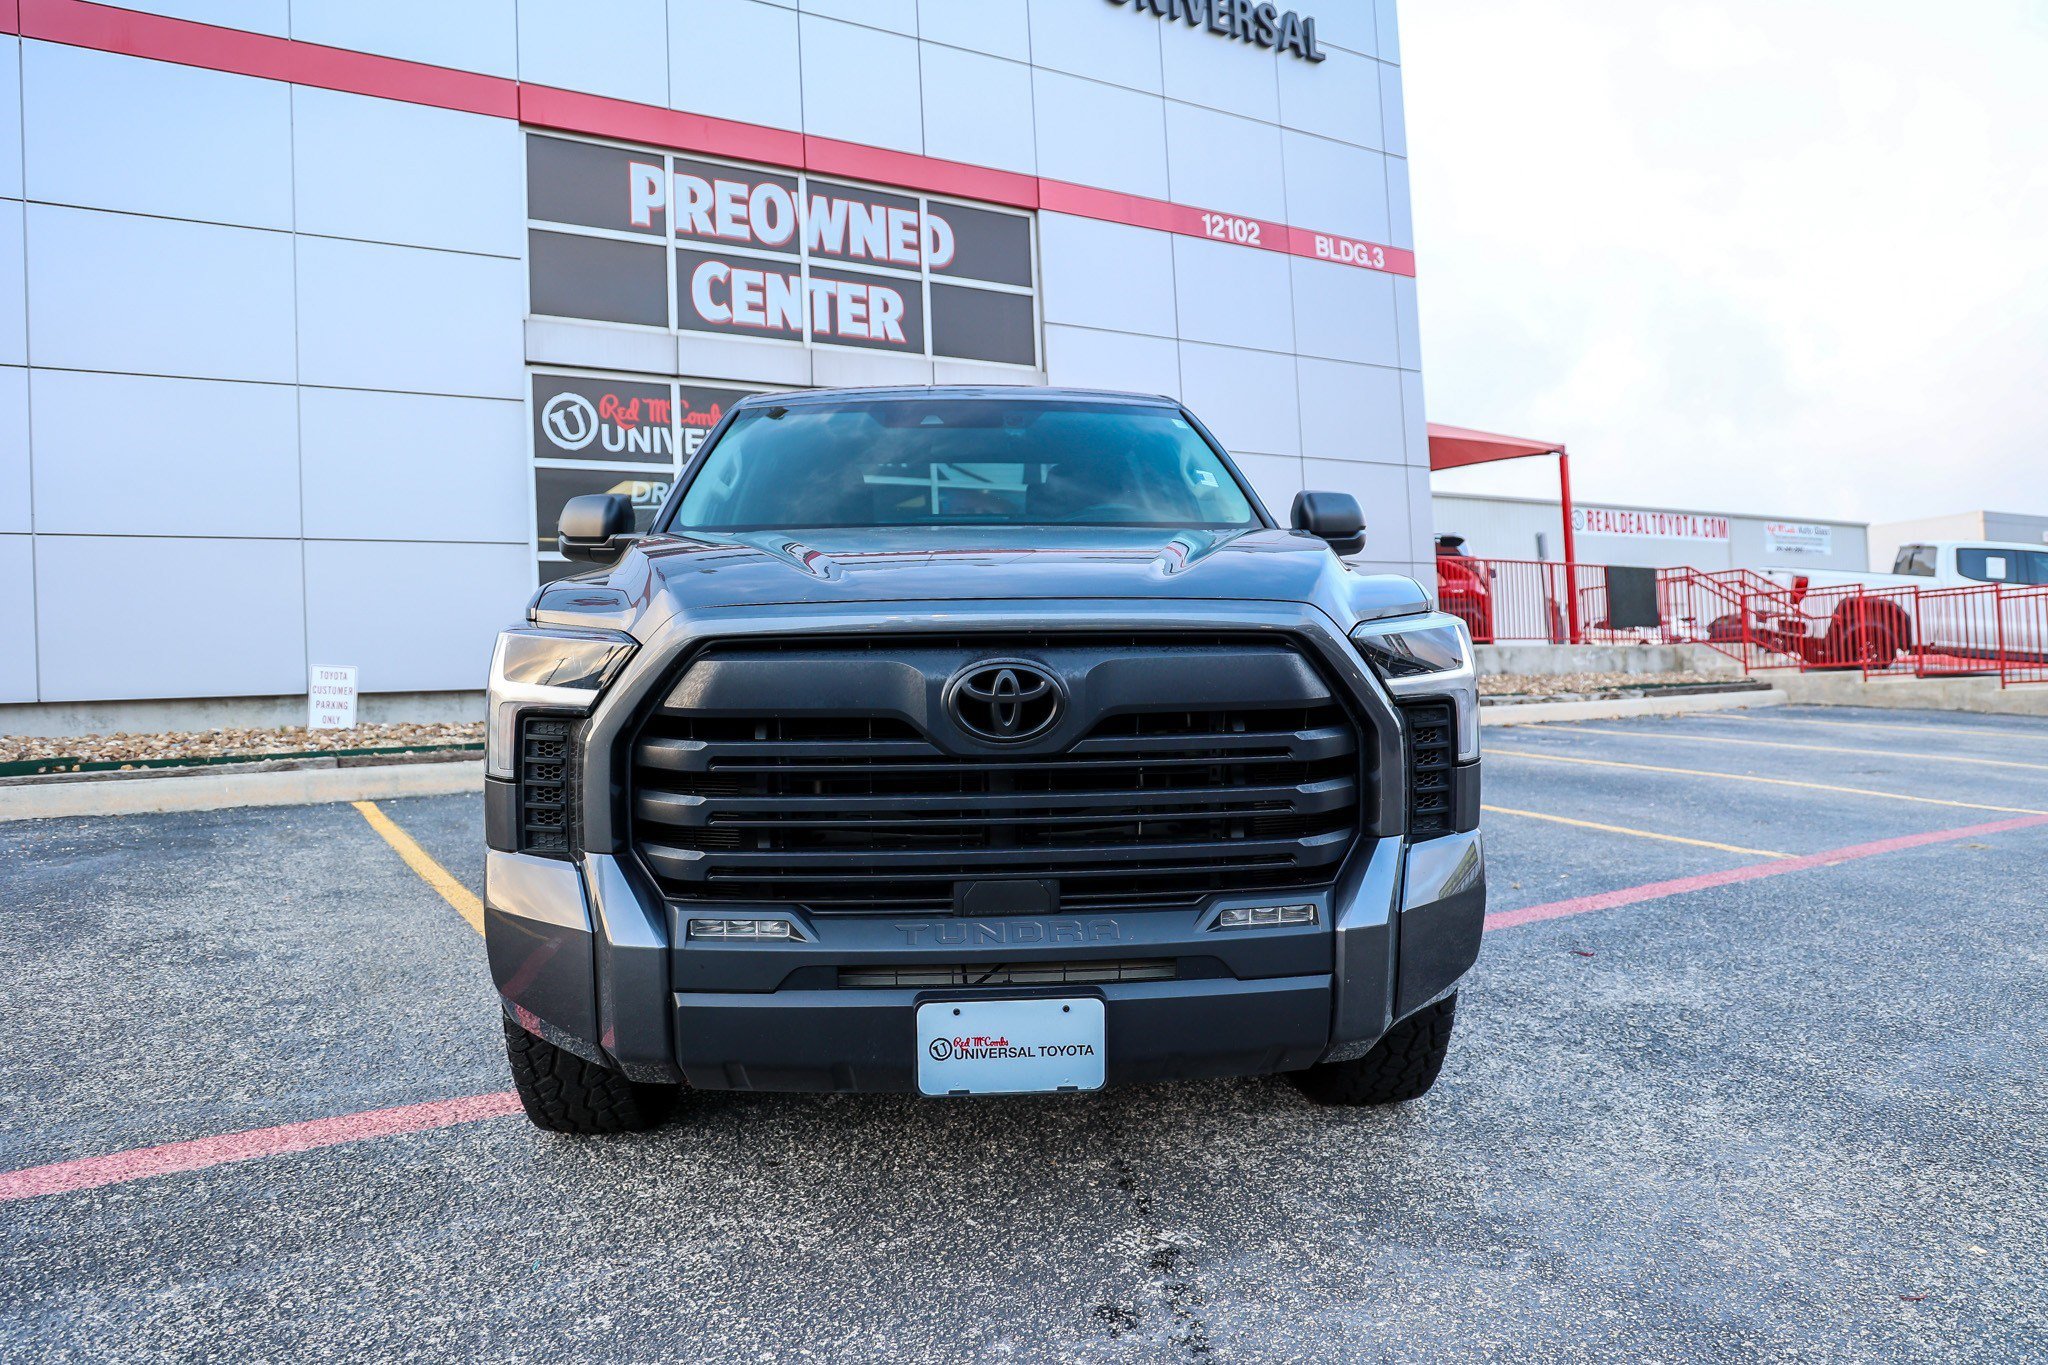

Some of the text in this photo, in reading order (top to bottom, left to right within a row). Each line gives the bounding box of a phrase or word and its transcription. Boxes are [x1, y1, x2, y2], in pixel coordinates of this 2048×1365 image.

[1105, 0, 1326, 63] IVERSAL
[630, 161, 955, 268] PREOWNED
[1202, 214, 1261, 245] 12102
[691, 261, 906, 342] CENTER
[599, 393, 722, 430] Red McComb
[601, 423, 711, 455] UNIVE
[1587, 510, 1728, 538] REALDEALTOYOTA.COM
[320, 670, 348, 680] TOYOTA
[312, 684, 353, 696] CUSTOMER
[316, 700, 348, 710] PARKING
[322, 715, 340, 724] ONLY
[894, 919, 1120, 945] TUNDRA
[953, 1037, 1009, 1051] Red McCombs
[954, 1044, 1094, 1060] UNIVERSAL TOYOTA
